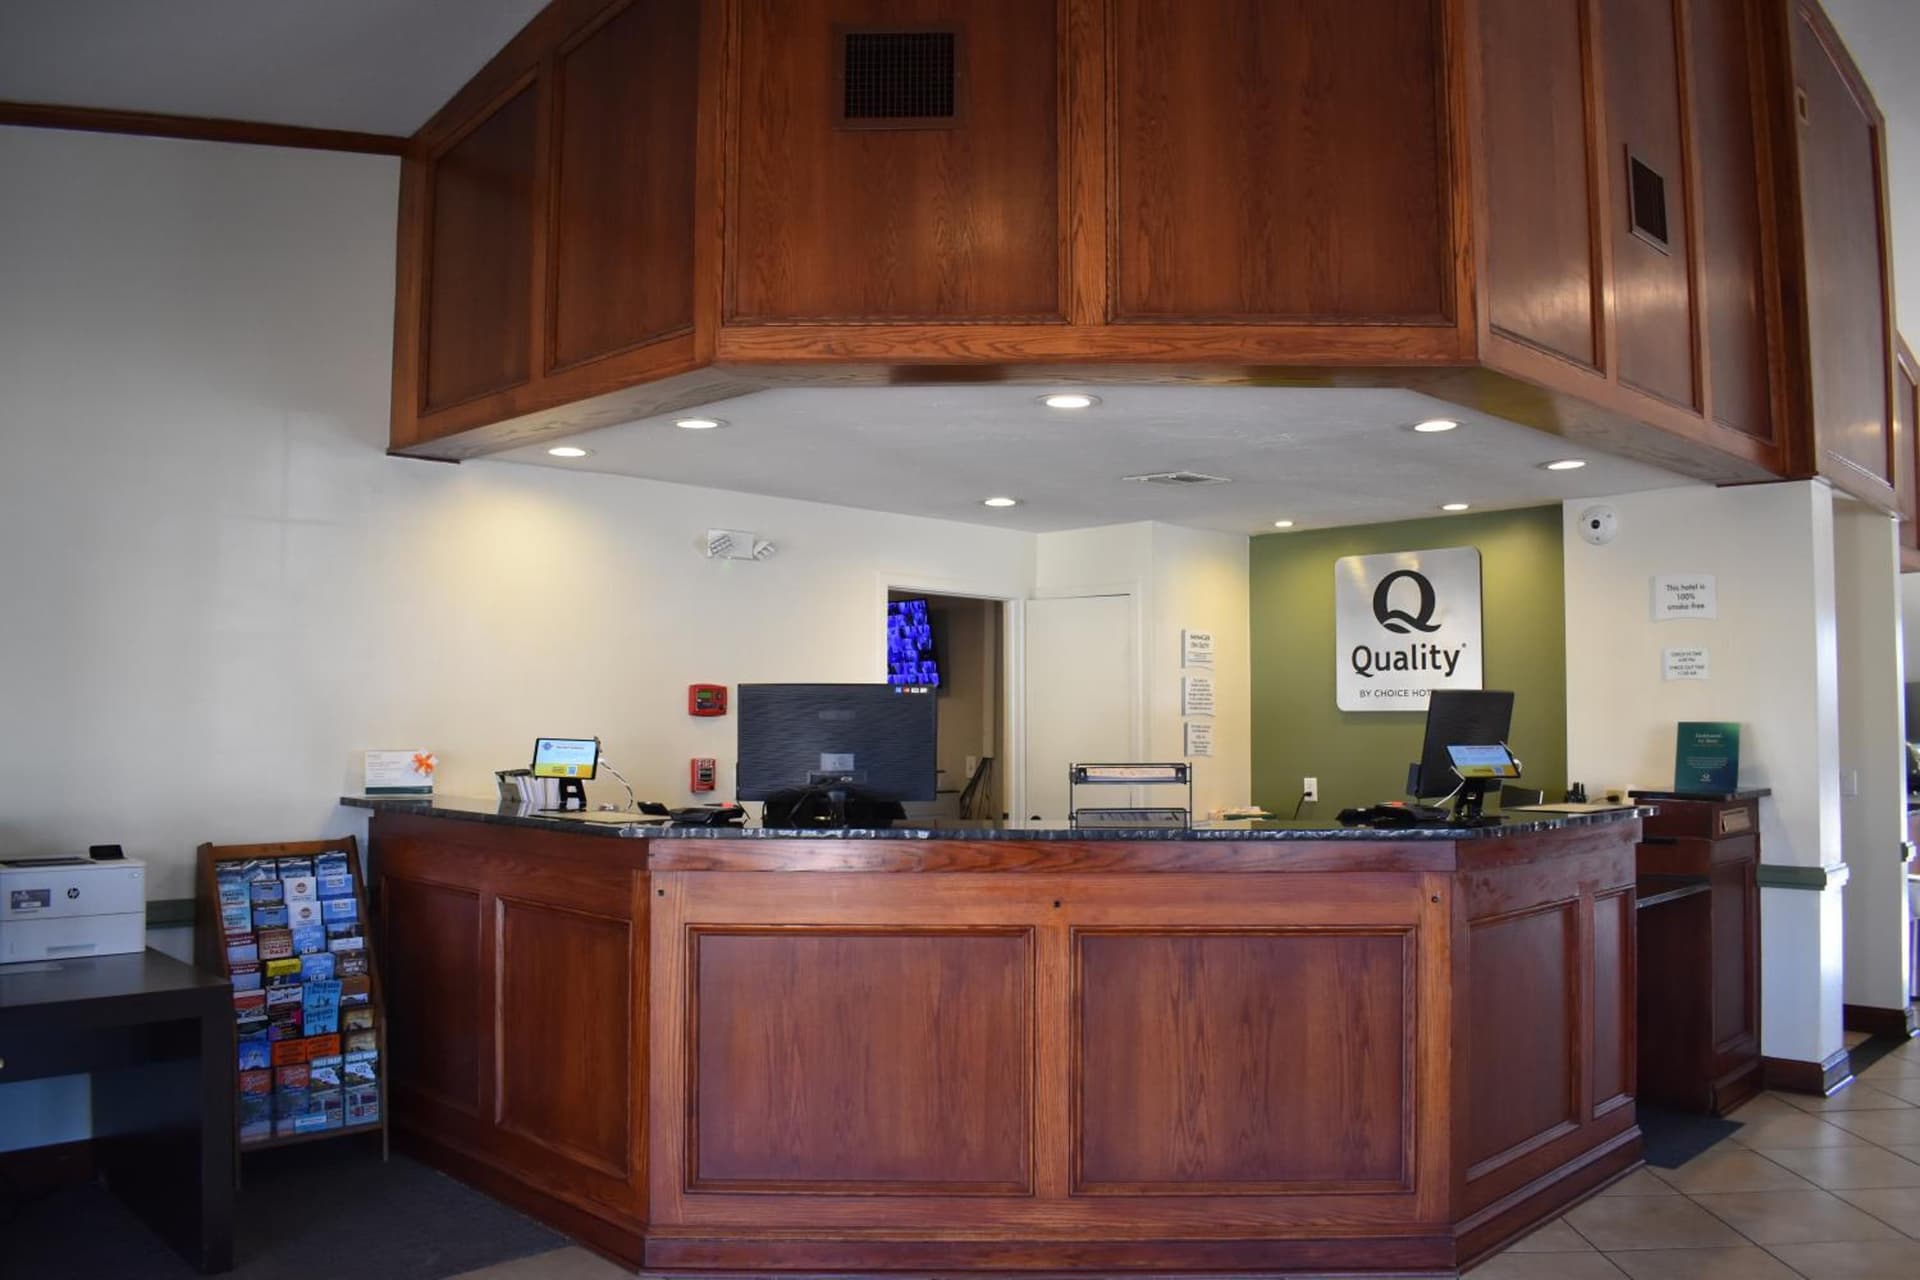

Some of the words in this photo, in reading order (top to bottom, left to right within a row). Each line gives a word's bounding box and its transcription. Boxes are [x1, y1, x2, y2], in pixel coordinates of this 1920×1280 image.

[1665, 584, 1679, 592] This
[1680, 583, 1698, 591] hotel
[1373, 569, 1442, 634] Q
[1676, 592, 1696, 601] 100%
[1352, 643, 1460, 678] Quality
[1359, 689, 1371, 698] BY
[1374, 688, 1409, 698] CHOICE
[1411, 688, 1432, 697] HOT
[67, 888, 80, 900] hp
